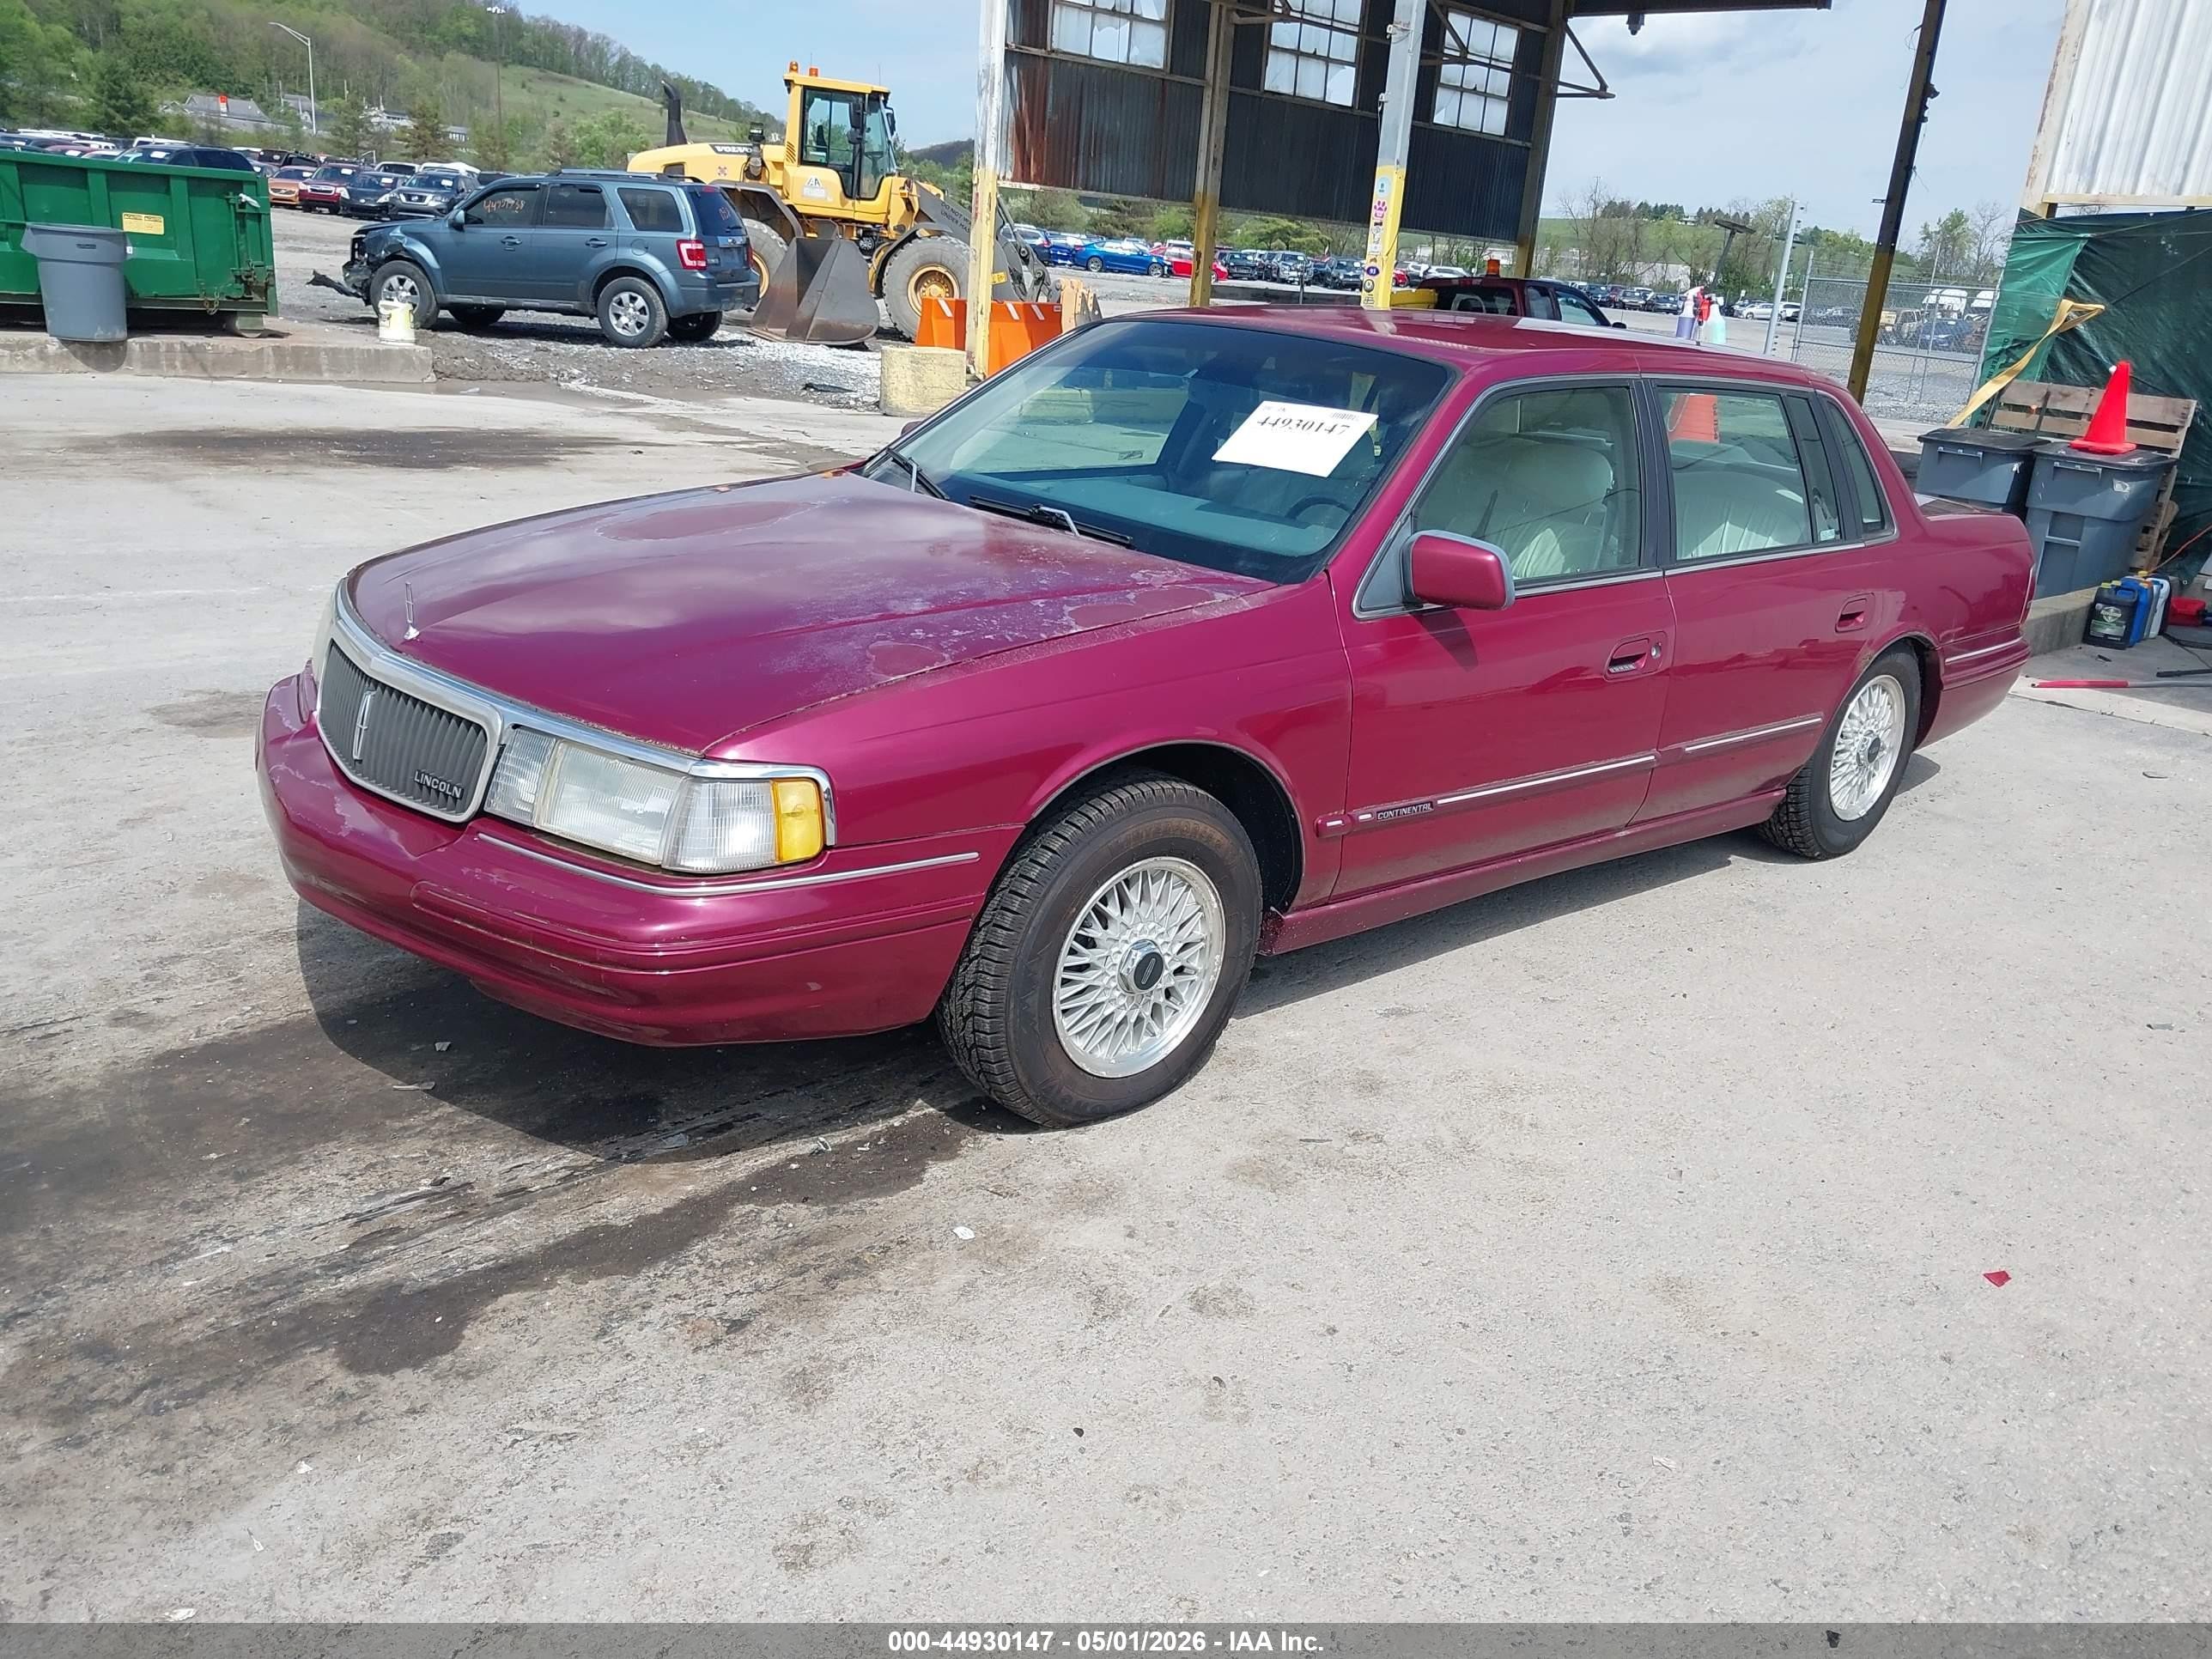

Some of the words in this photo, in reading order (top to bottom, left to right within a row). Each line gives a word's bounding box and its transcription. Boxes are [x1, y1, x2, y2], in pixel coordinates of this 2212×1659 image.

[940, 210, 958, 225] UNDER
[951, 208, 963, 218] NOT
[1256, 416, 1351, 436] 44930147
[413, 769, 463, 799] LINCOLN
[1377, 802, 1433, 821] CONTINENTAL
